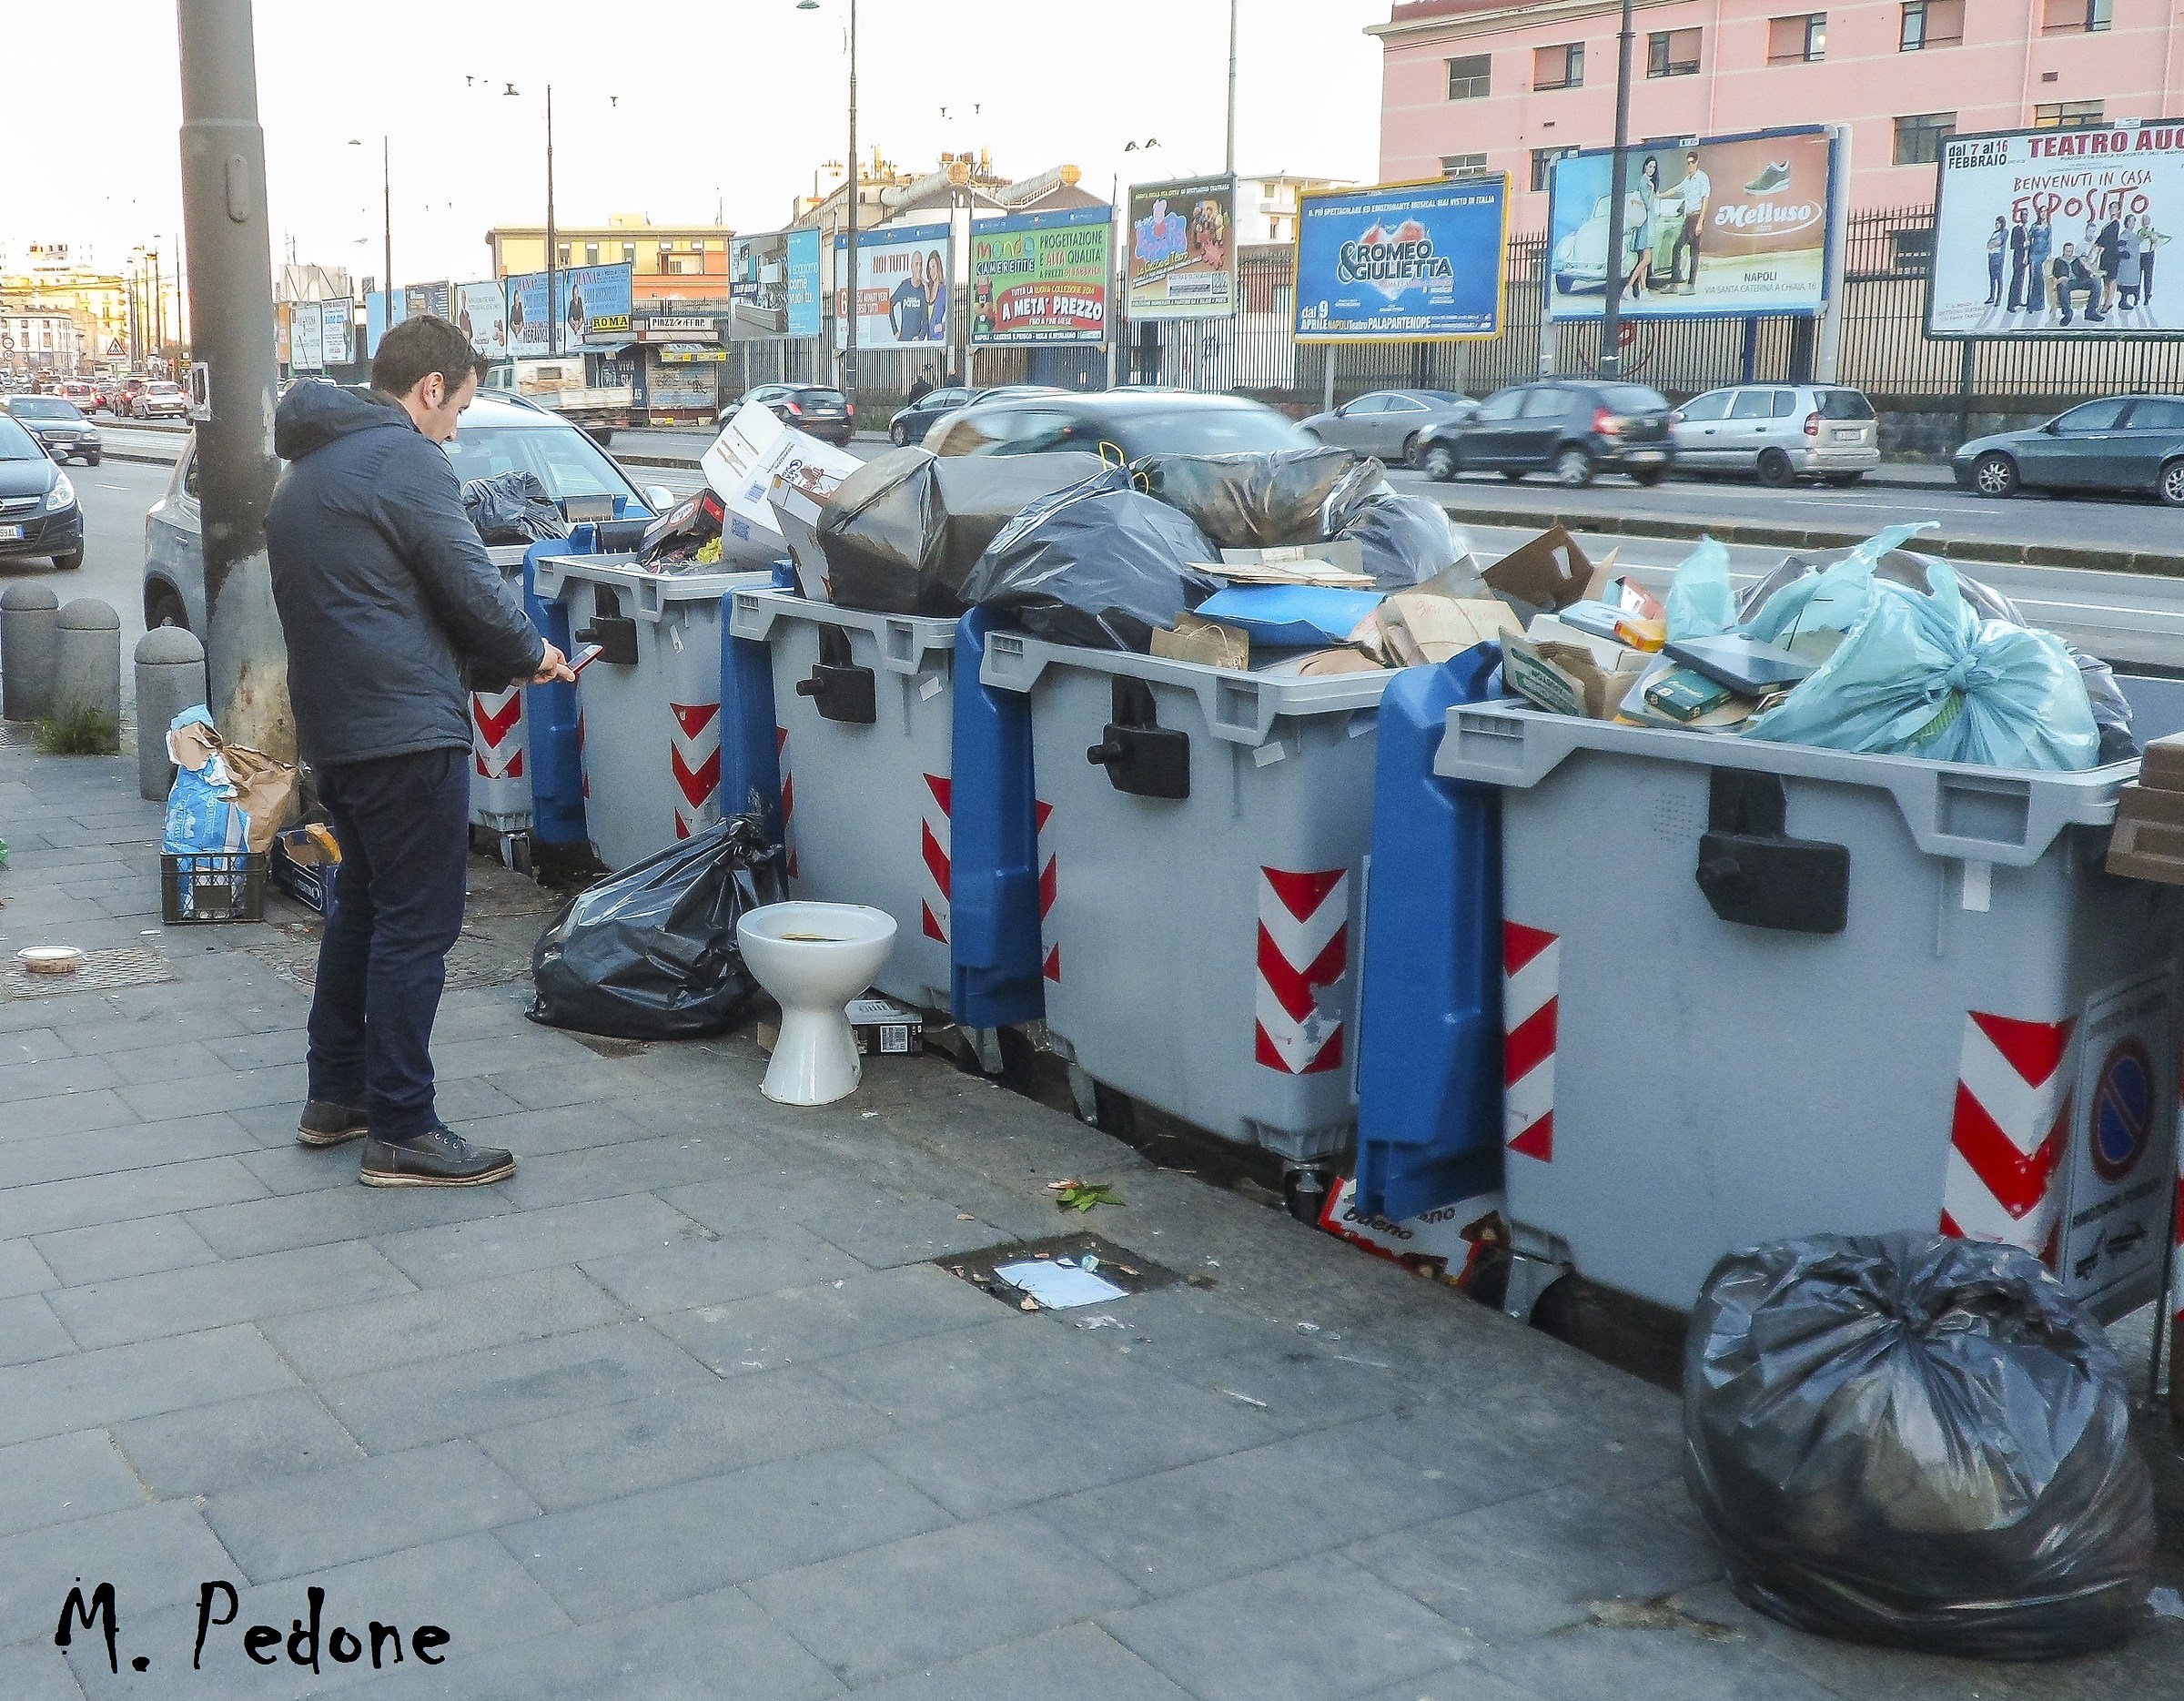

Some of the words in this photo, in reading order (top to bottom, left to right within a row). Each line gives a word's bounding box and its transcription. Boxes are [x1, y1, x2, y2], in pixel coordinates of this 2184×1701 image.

[1948, 144, 1967, 157] dal
[1971, 143, 1979, 153] 7
[1983, 140, 1993, 153] al
[1996, 139, 2008, 153] 16
[2027, 131, 2128, 158] TEATRO
[1948, 154, 2007, 169] FEBBRAIO
[2014, 172, 2092, 193] BENVENUTI
[2098, 171, 2114, 186] IN
[2121, 168, 2153, 186] CASA
[1714, 201, 1812, 228] Melluso
[2011, 186, 2151, 226] ESPOSITO
[1039, 229, 1103, 249] PROGETTAZIONE
[1355, 238, 1434, 263] ROMEO
[873, 255, 887, 274] NOI
[888, 253, 909, 273] TUTTI
[976, 258, 1036, 276] CAMERETTE
[1039, 255, 1045, 267] E
[1355, 257, 1454, 282] GIULIETTA
[789, 278, 808, 290] come
[1744, 271, 1778, 282] NAPOLI
[789, 292, 804, 304] vuoi
[1002, 302, 1013, 321] A
[1014, 297, 1049, 318] META'
[1052, 295, 1104, 321] PREZZO
[1301, 306, 1317, 319] dal
[1320, 299, 1329, 318] 9
[592, 316, 628, 328] ROMA
[1301, 319, 1329, 330] APRILE
[1349, 319, 1368, 330] Teatro
[1368, 315, 1431, 330] PALAPARTENOPE
[1342, 1206, 1414, 1240] bueno
